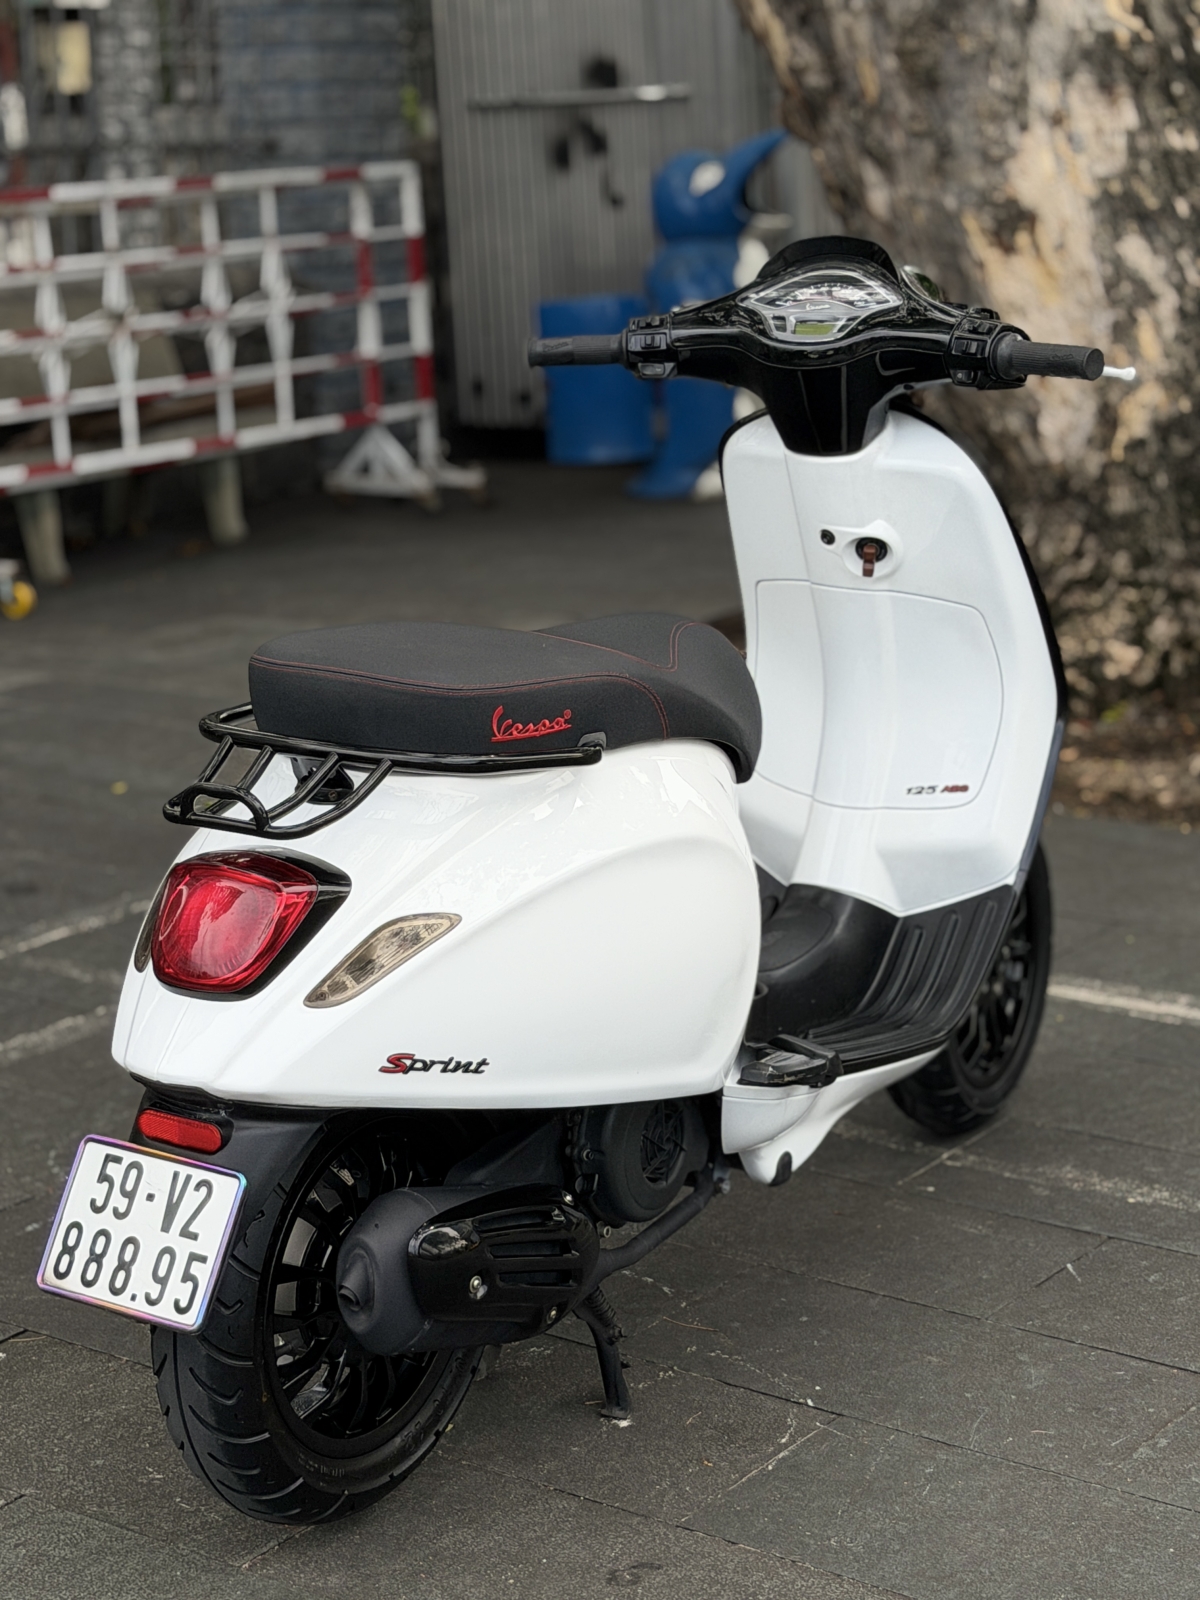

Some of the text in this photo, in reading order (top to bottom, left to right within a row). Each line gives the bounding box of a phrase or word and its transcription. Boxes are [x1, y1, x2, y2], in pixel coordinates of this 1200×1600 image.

[491, 705, 572, 742] Vespa
[906, 784, 938, 795] 125
[378, 1053, 490, 1075] Sprint
[53, 1220, 209, 1316] 888.95
